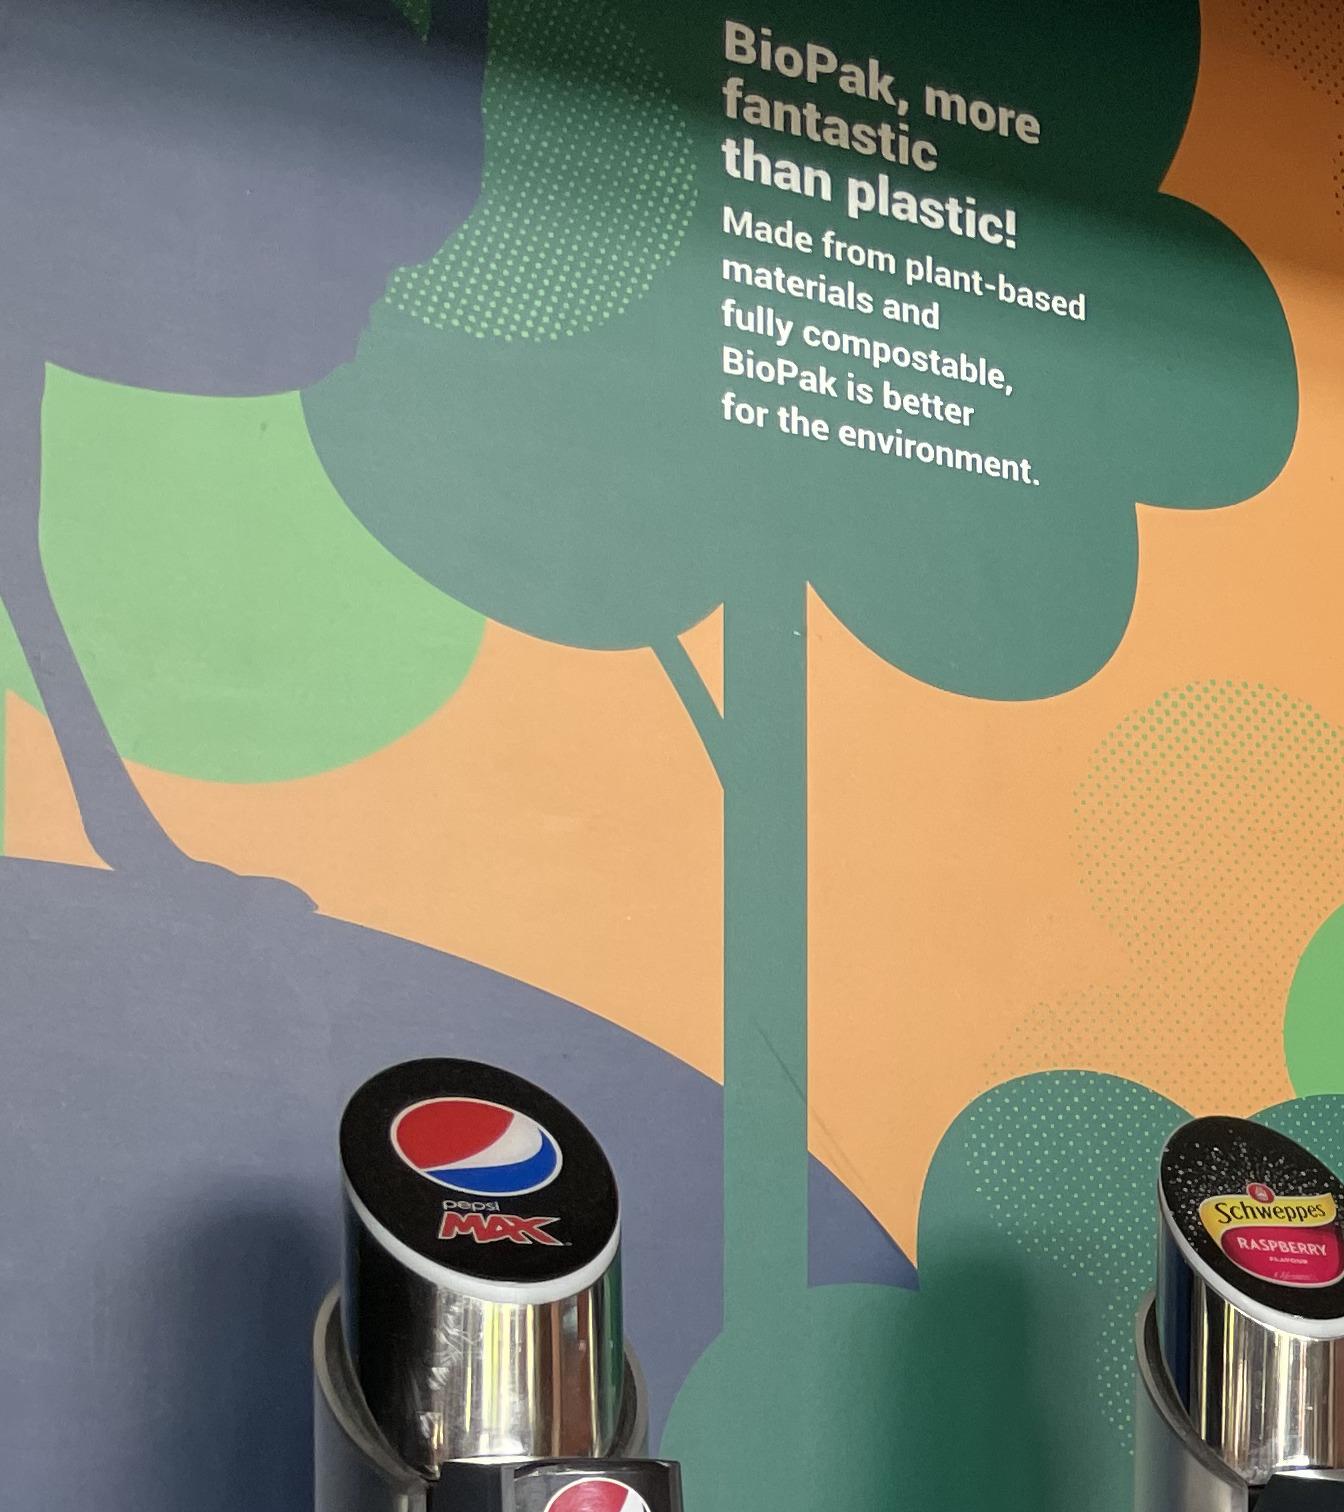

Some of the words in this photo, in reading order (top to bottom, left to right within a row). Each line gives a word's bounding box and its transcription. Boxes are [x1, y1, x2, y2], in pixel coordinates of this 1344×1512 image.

[722, 77, 938, 171] fantastic
[725, 20, 909, 115] BioPak,
[925, 85, 1040, 145] more
[721, 138, 831, 202] than
[848, 174, 1016, 248] plastic!
[723, 206, 812, 253] Made
[821, 230, 895, 273] from
[907, 256, 1085, 321] plant-based
[723, 259, 873, 314] materials
[883, 296, 939, 330] and
[722, 299, 792, 346] fully
[803, 325, 1012, 395] compostable,
[723, 346, 837, 397] BioPak
[847, 373, 873, 405] is
[883, 381, 974, 426] better
[722, 393, 768, 427] for
[778, 405, 829, 441] the
[839, 424, 1039, 486] environment.
[438, 1211, 564, 1246] MAX
[443, 1200, 500, 1212] pepsi
[1215, 1201, 1325, 1223] Schweppes
[1237, 1237, 1326, 1256] RASPBERRY
